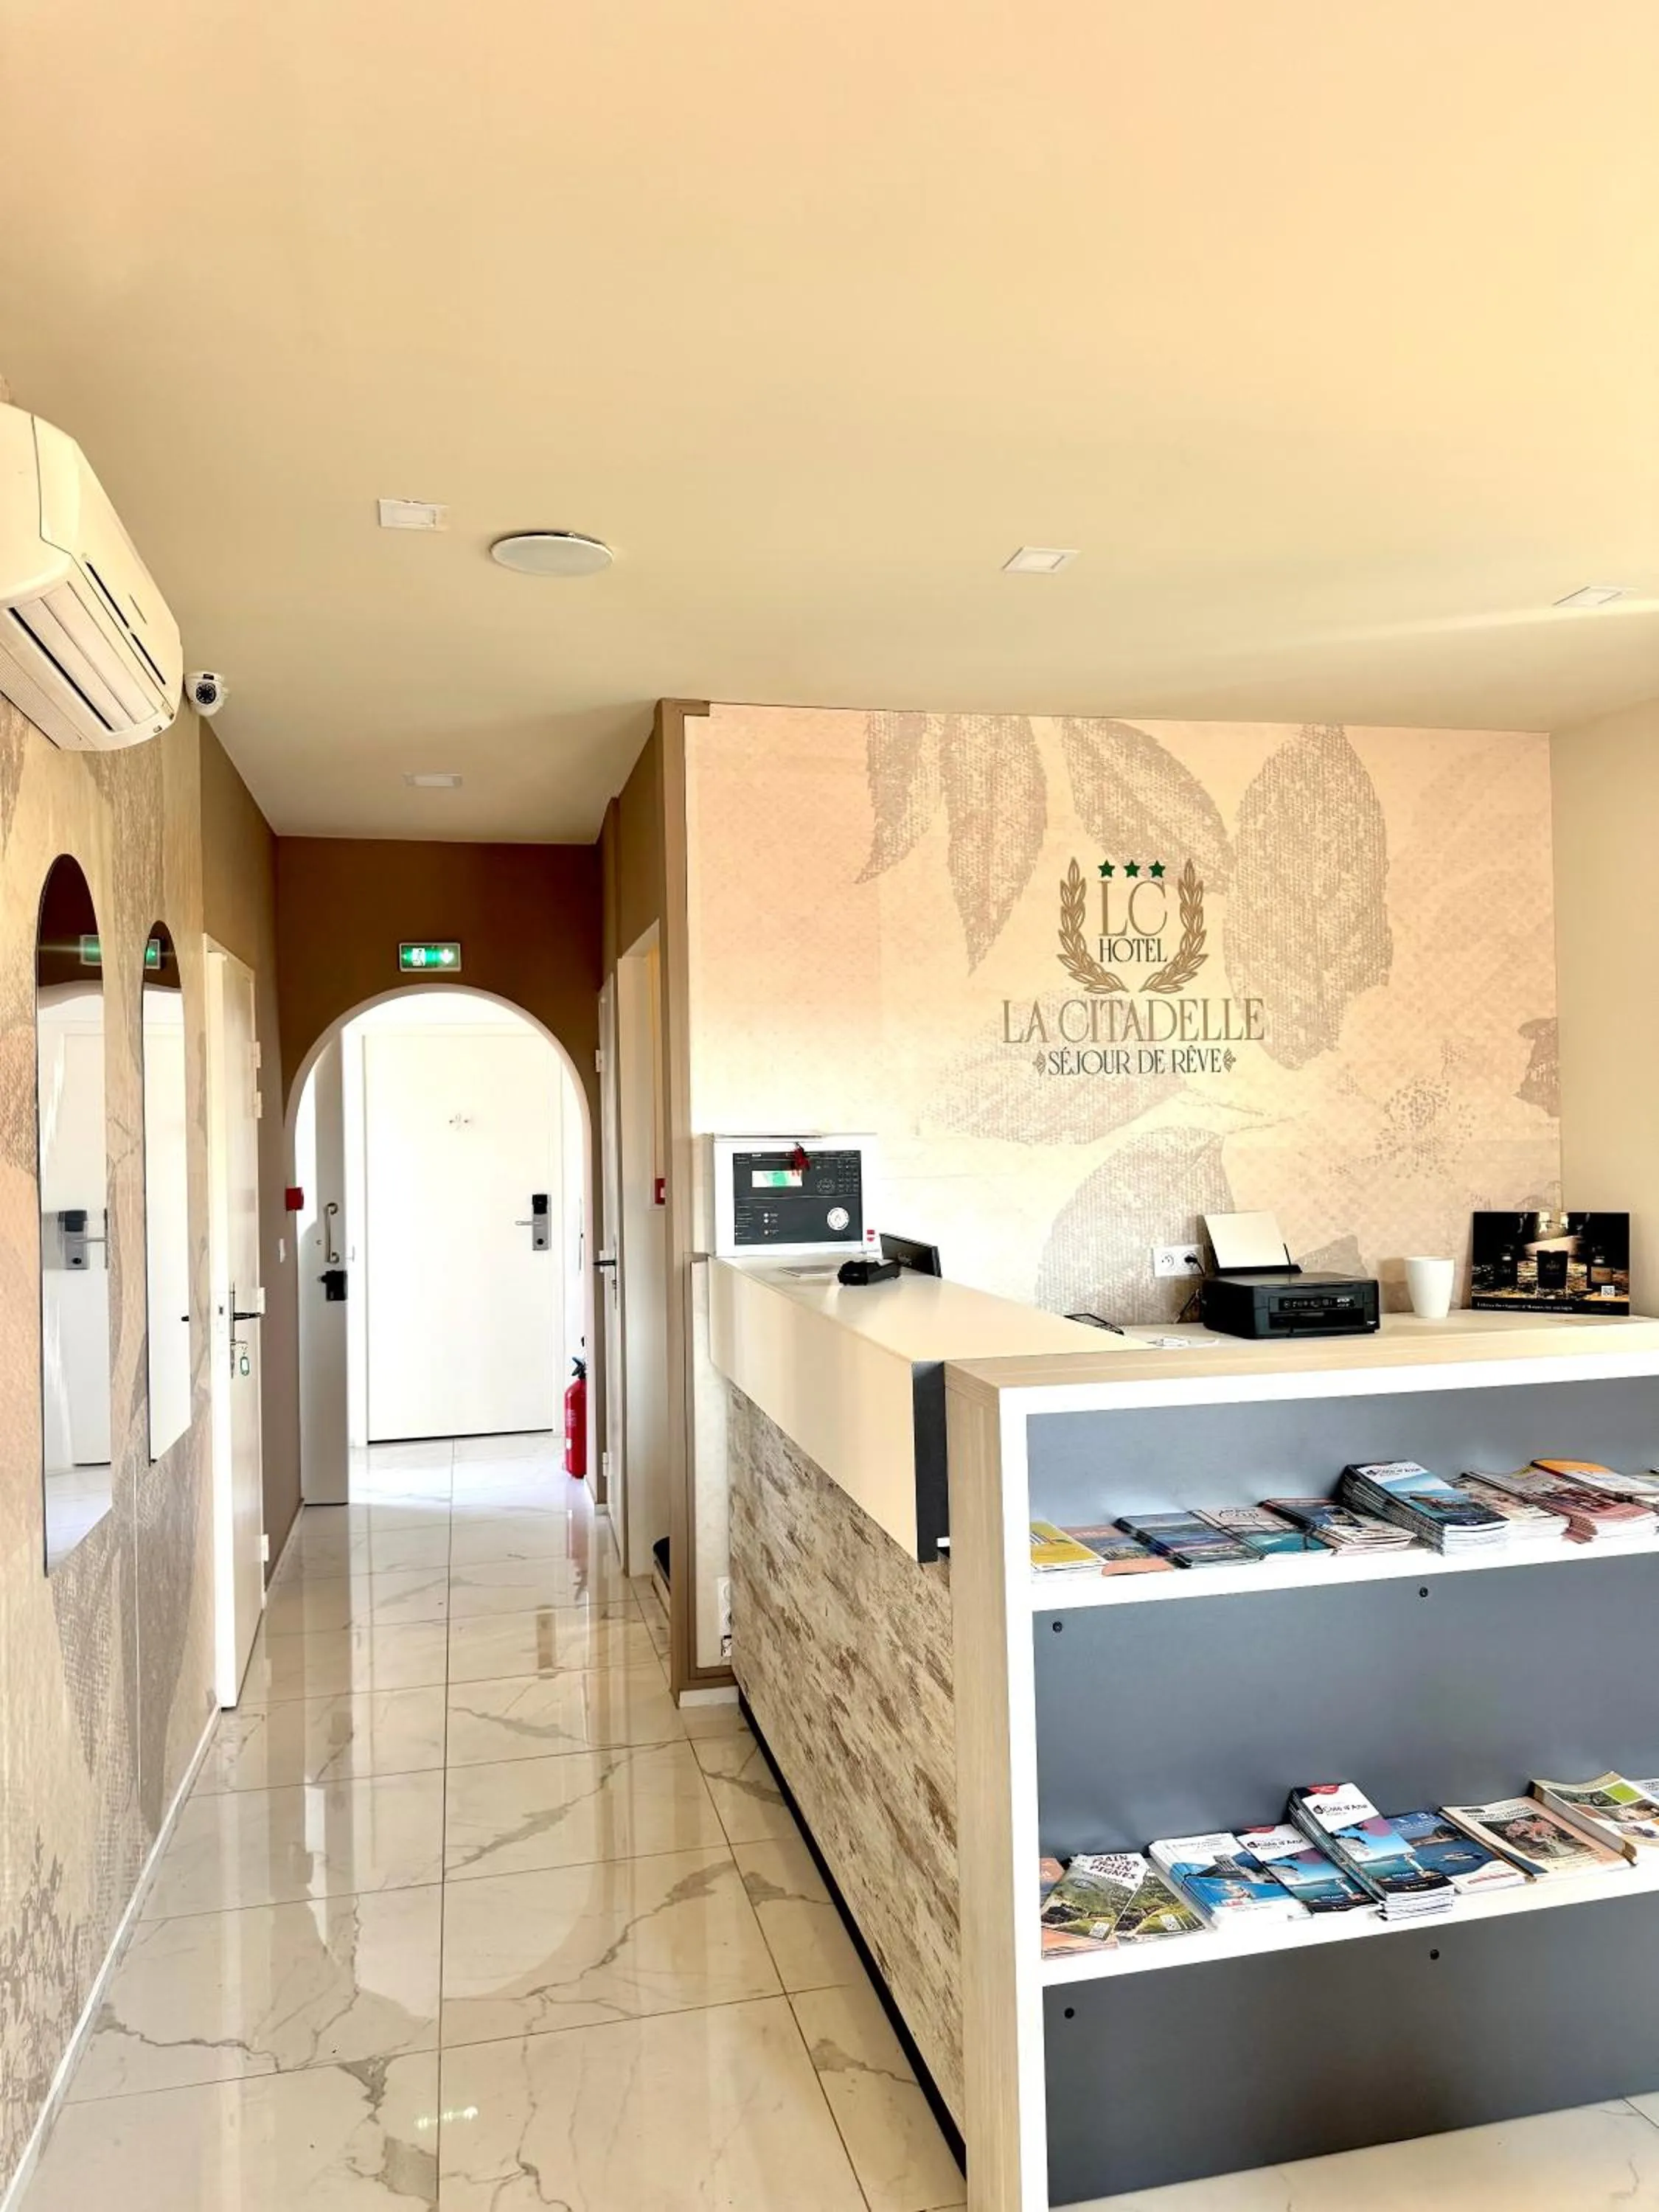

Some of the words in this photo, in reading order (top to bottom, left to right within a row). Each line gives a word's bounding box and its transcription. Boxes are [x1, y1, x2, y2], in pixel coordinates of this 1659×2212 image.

[1098, 880, 1168, 937] LC
[1099, 938, 1168, 962] HOTEL
[1002, 999, 1050, 1043] LA
[1058, 997, 1265, 1043] CITADELLE
[1048, 1046, 1131, 1075] SÉJOUR
[1138, 1049, 1166, 1074] DE
[1171, 1044, 1222, 1074] RÊVE
